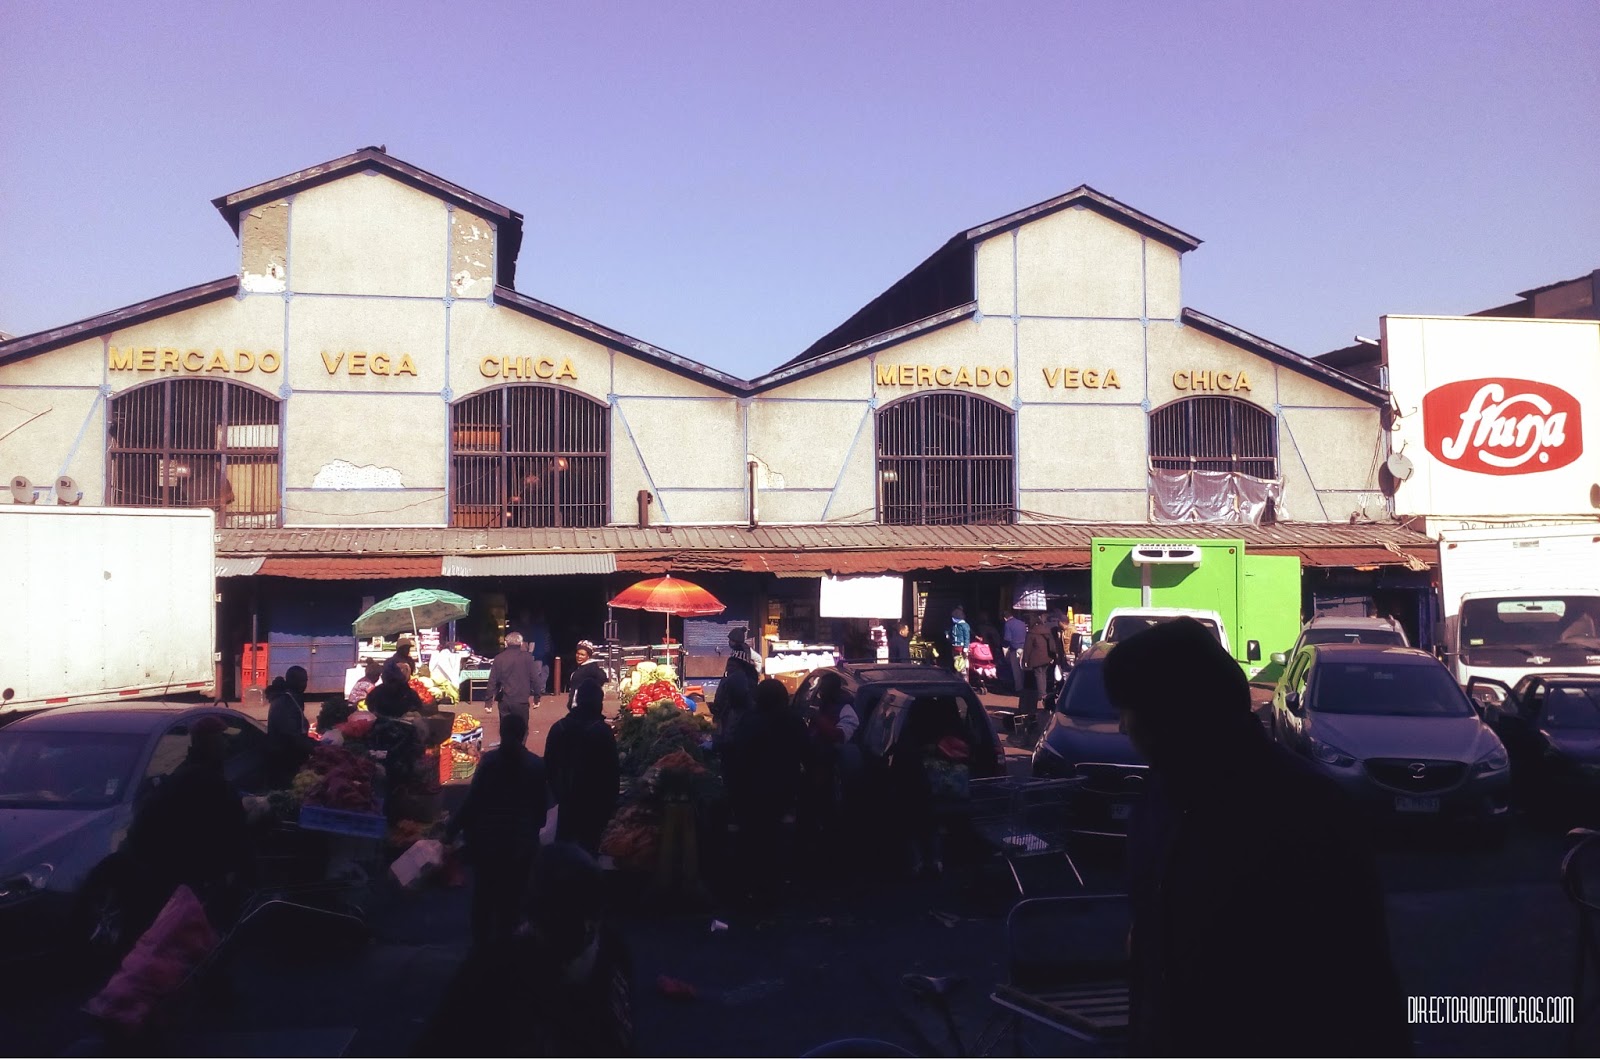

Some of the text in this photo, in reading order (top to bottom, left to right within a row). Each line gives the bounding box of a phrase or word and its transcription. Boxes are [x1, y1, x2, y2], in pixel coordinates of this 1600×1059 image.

[109, 345, 578, 380] MERCADO VEGA CHICA
[876, 363, 1252, 392] MERCADO VEGA CHICA
